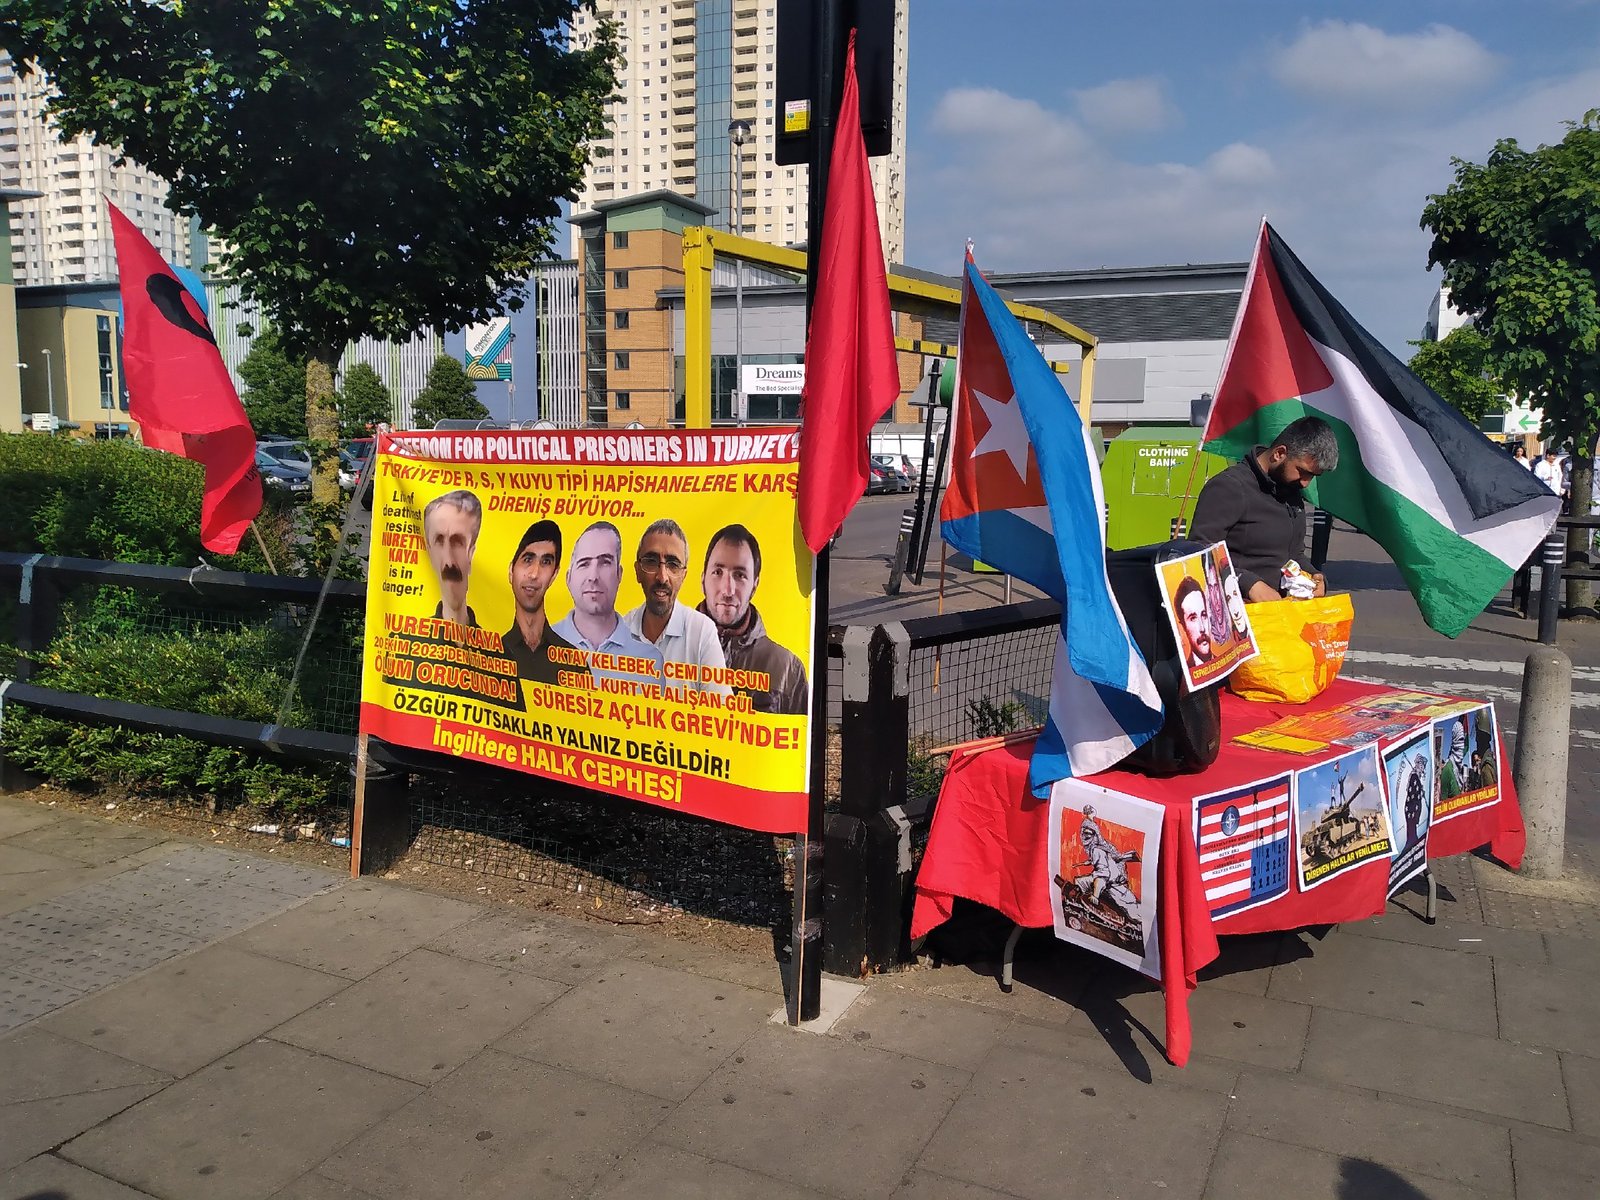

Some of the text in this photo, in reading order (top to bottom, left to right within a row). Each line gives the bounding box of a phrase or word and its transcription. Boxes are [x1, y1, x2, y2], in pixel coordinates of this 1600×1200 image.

[473, 321, 497, 352] EDMONTON
[756, 367, 803, 379] Dreams
[455, 436, 485, 460] FOR
[488, 436, 571, 461] POLITICAL
[575, 436, 682, 462] PRISONERS
[686, 436, 707, 462] IN
[711, 432, 800, 461] TURKEY!
[1139, 448, 1188, 457] CLOTHING
[1149, 458, 1176, 467] BANK
[480, 472, 495, 490] S,
[498, 472, 506, 489] Y
[510, 473, 553, 491] KUYU
[556, 469, 588, 492] TİPİ
[592, 470, 738, 493] HAPİSHANELERE
[743, 472, 799, 499] KARŞ
[488, 492, 645, 519] DİRENİŞ BÜYÜYOR...
[389, 548, 418, 564] KAYA
[389, 565, 413, 579] is in
[383, 580, 424, 597] danger!
[384, 612, 504, 653] NURETTİN KAYA
[374, 636, 383, 648] 20
[384, 635, 411, 655] EKİM
[411, 641, 468, 665] 2023'DEN
[374, 650, 517, 702] ÖLÜM ORUCUNDA!
[548, 645, 770, 691] OKTAY KELEBEK, CEM DURSUN
[558, 670, 756, 715] CEMİL KURT VE ALİŞAN GÜL
[533, 685, 799, 750] SÜRESİZ AÇLIK GREVİ'NDE!
[394, 688, 730, 780] ÖZGÜR TUTSAKLAR YALNIZ DEĞİLDİR!
[432, 718, 683, 804] İngiltere HALK CEPHESİ
[1330, 853, 1355, 871] HALKLAR
